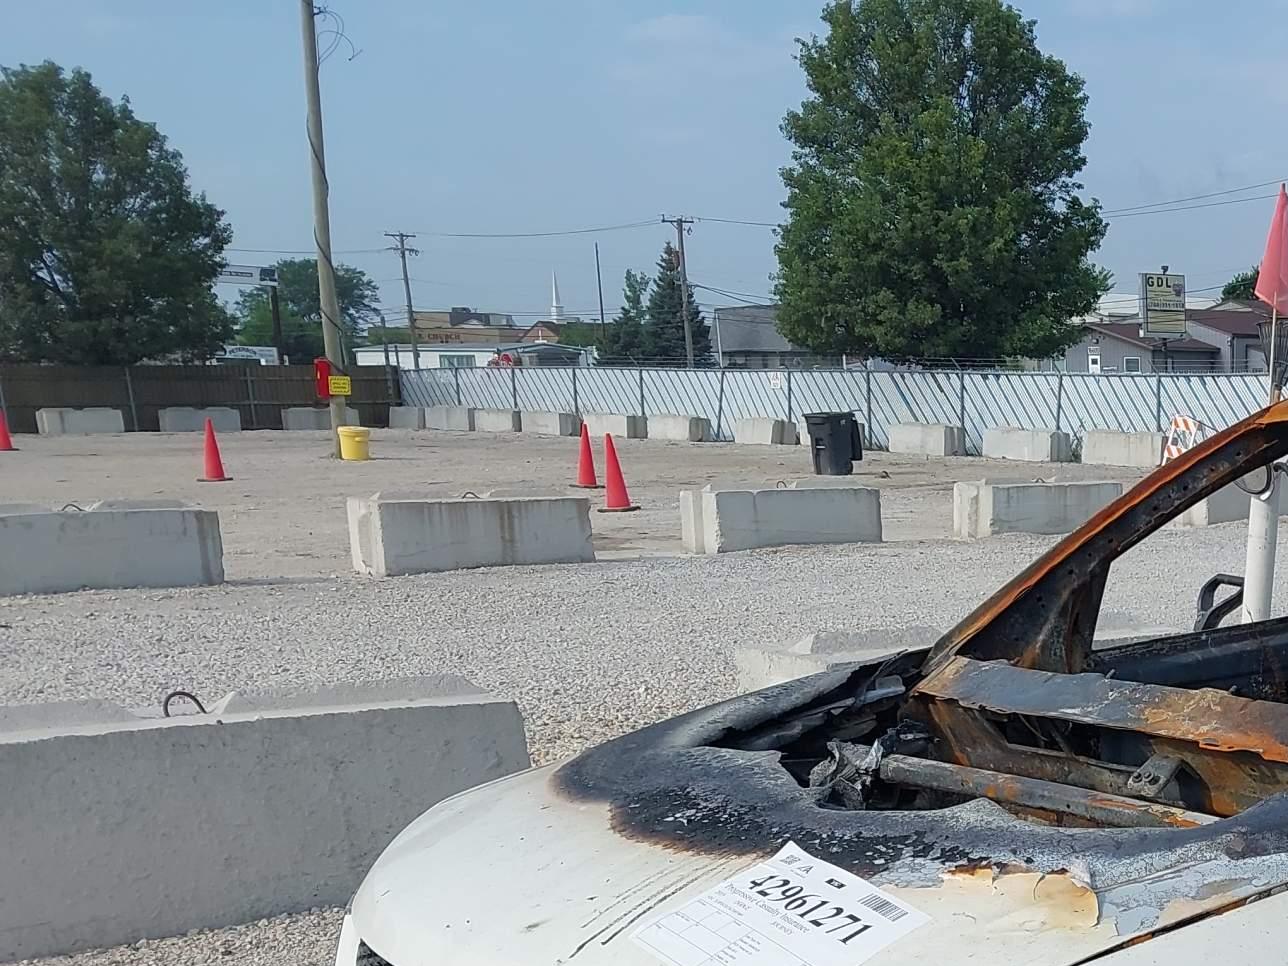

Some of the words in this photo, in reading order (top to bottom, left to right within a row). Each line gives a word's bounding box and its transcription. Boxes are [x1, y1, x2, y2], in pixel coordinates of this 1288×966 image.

[1147, 276, 1171, 288] GDL
[750, 874, 873, 945] 42961271
[778, 913, 811, 934] Insurance
